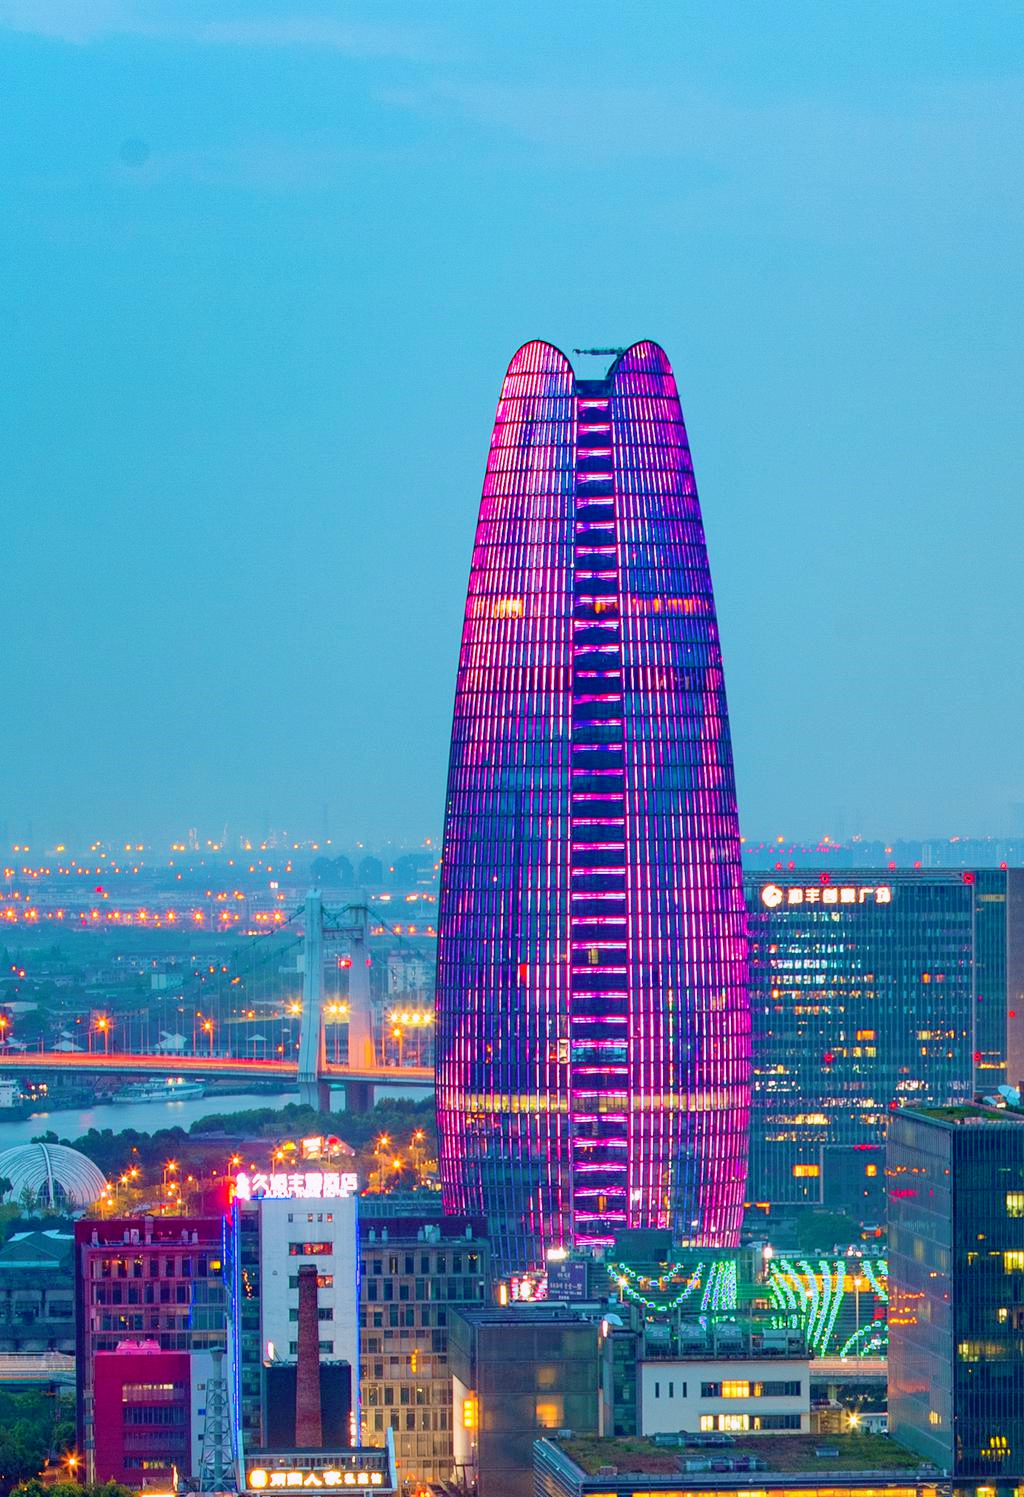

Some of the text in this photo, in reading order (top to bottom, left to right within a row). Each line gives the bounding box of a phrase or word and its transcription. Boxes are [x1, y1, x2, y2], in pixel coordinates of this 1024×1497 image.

[787, 887, 891, 904] 和丰创意广场
